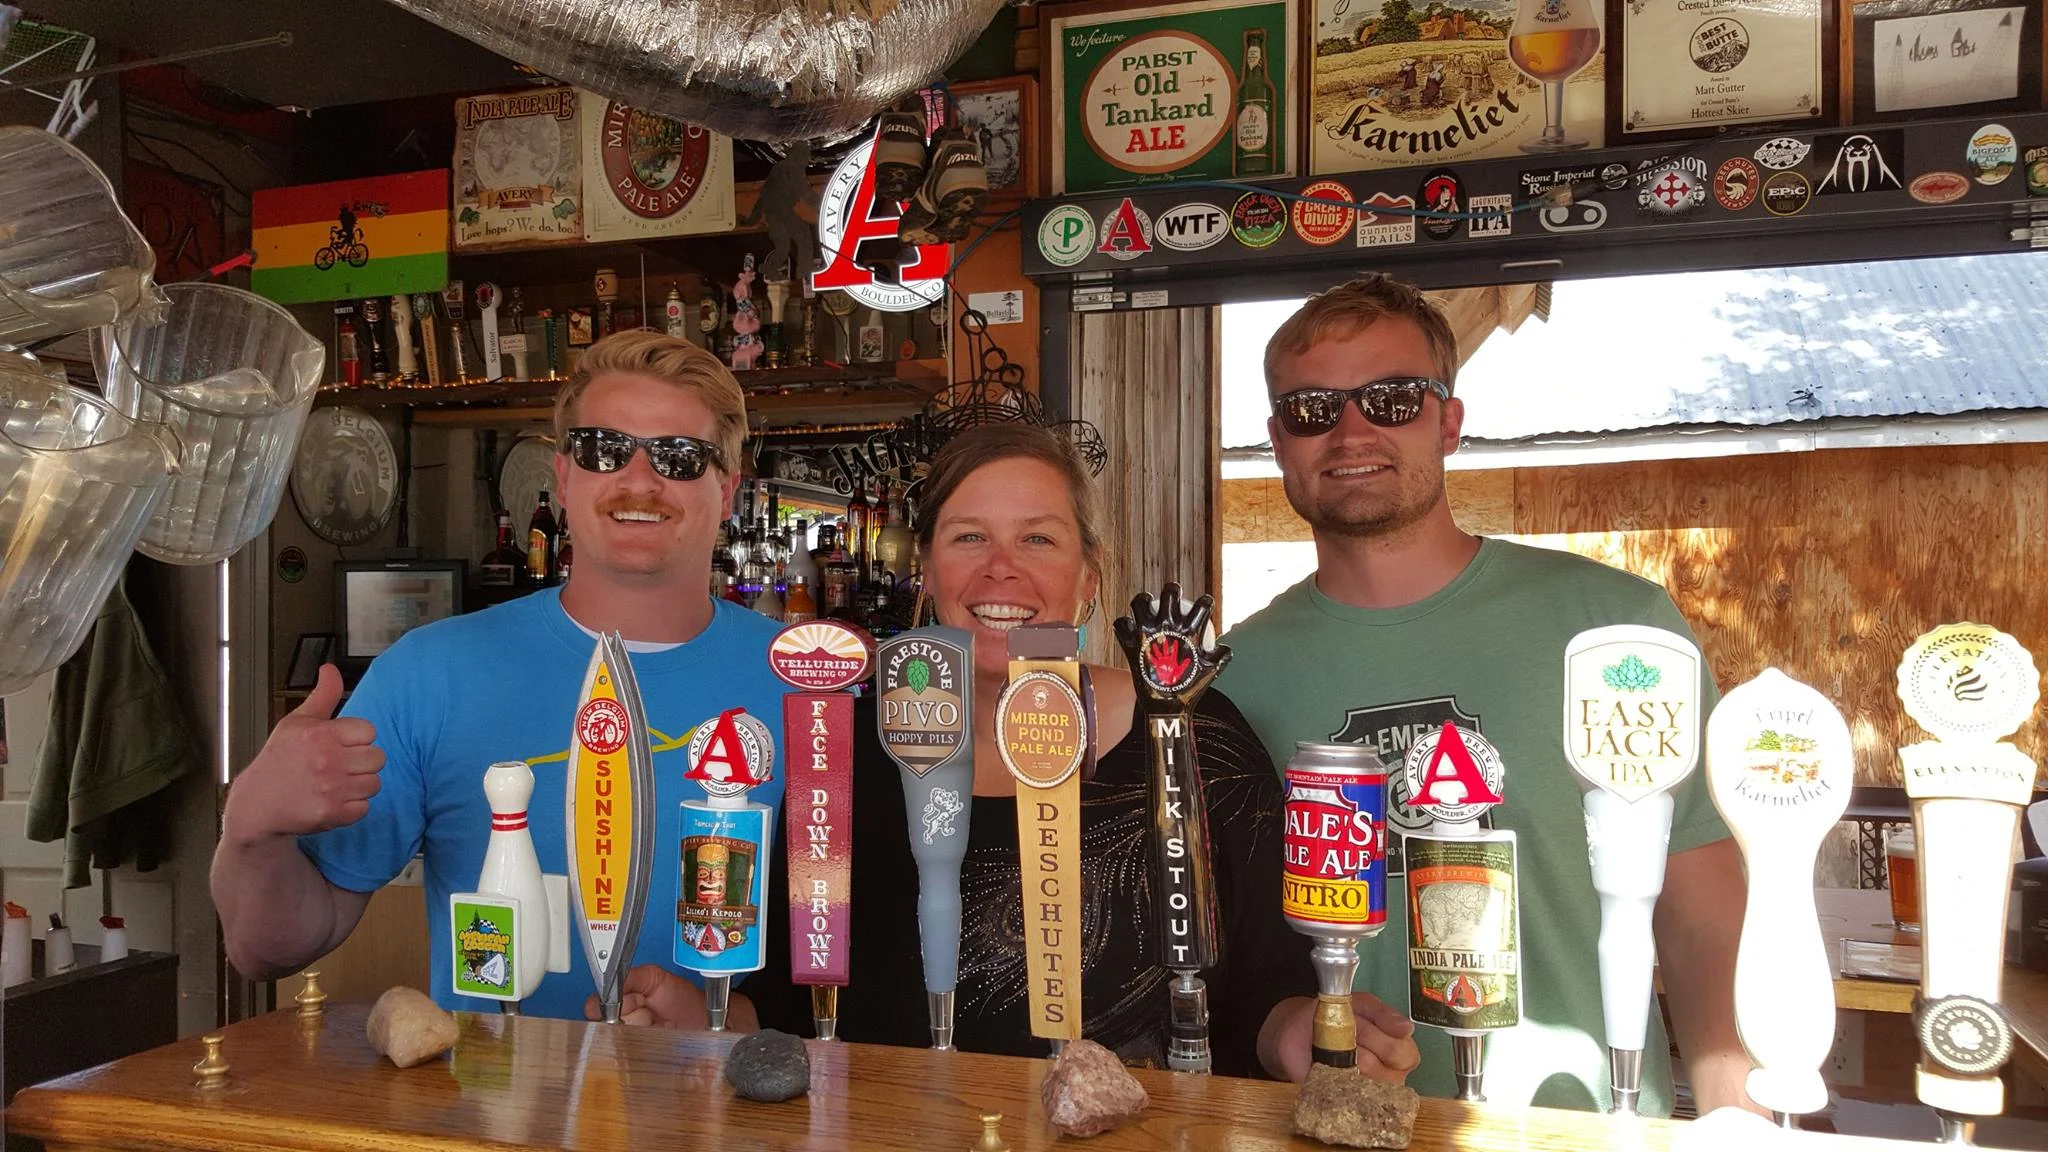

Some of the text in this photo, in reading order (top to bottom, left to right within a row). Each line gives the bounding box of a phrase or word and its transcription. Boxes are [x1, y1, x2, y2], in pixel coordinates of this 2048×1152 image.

[1070, 29, 1126, 57] We feature
[1700, 22, 1727, 41] BEST
[1705, 29, 1740, 51] BUTTE
[1122, 50, 1198, 72] PABST
[1134, 71, 1180, 96] Old
[1695, 83, 1746, 96] Matt Gutter
[464, 89, 574, 129] INDIA PALE ALE
[1102, 94, 1215, 127] Tankard
[1691, 104, 1750, 119] Hottest Skier
[1326, 89, 1520, 154] Karmeliet
[1125, 125, 1187, 153] ALE
[947, 152, 978, 166] MIZU
[1972, 147, 2012, 156] BIGFOOT
[2025, 146, 2048, 165] MIS
[1522, 168, 1597, 186] Stone Imperial
[1717, 160, 1756, 181] DESCHUTES
[495, 188, 536, 203] AVERY
[618, 172, 695, 211] PALE ALE
[826, 157, 862, 235] AVERY
[1235, 195, 1258, 219] BRICK
[1471, 205, 1510, 232] IPA
[460, 224, 482, 242] Love
[485, 219, 513, 236] hops?
[515, 217, 535, 233] We
[557, 219, 578, 234] too!
[1165, 212, 1221, 237] WTF
[1244, 213, 1275, 226] PIZZA
[1304, 212, 1343, 227] DIVIDE
[1360, 232, 1412, 246] TRAILS
[924, 281, 941, 297] CO
[489, 331, 498, 364] Salvator
[331, 415, 390, 481] BELGIUM
[312, 517, 378, 541] BREWING
[778, 658, 859, 671] TELLURIDE
[789, 669, 847, 679] BREWING CO
[887, 642, 953, 690] FIRESTONE
[581, 702, 626, 728] NEW BELGIUM
[884, 700, 960, 727] PIVO
[1011, 711, 1070, 727] MIRROR
[1580, 699, 1684, 729] EASY
[810, 700, 830, 772] FACE
[889, 732, 954, 744] HOPPY PILS
[1018, 727, 1065, 742] POND
[1581, 728, 1682, 758] JACK
[587, 742, 619, 753] BREWING
[692, 724, 711, 757] AVERY
[738, 726, 759, 771] BREWING
[1011, 742, 1073, 757] PALE ALE
[1157, 718, 1181, 819] MILK
[1411, 736, 1495, 788] AVERY BREWING
[1610, 762, 1654, 783] IPA
[1323, 776, 1342, 784] PALE
[807, 789, 833, 860] DOWN
[595, 760, 613, 914] SUNSHINE
[1284, 846, 1373, 876] ALE ALE
[1167, 838, 1189, 963] STOUT
[1283, 880, 1363, 909] NITRO
[712, 908, 742, 918] KEPOLO
[807, 879, 833, 969] BROWN
[1036, 801, 1065, 1024] DESCHUTES
[590, 923, 618, 932] WHEAT
[1414, 951, 1448, 968] INDIA
[1452, 952, 1484, 969] PALE
